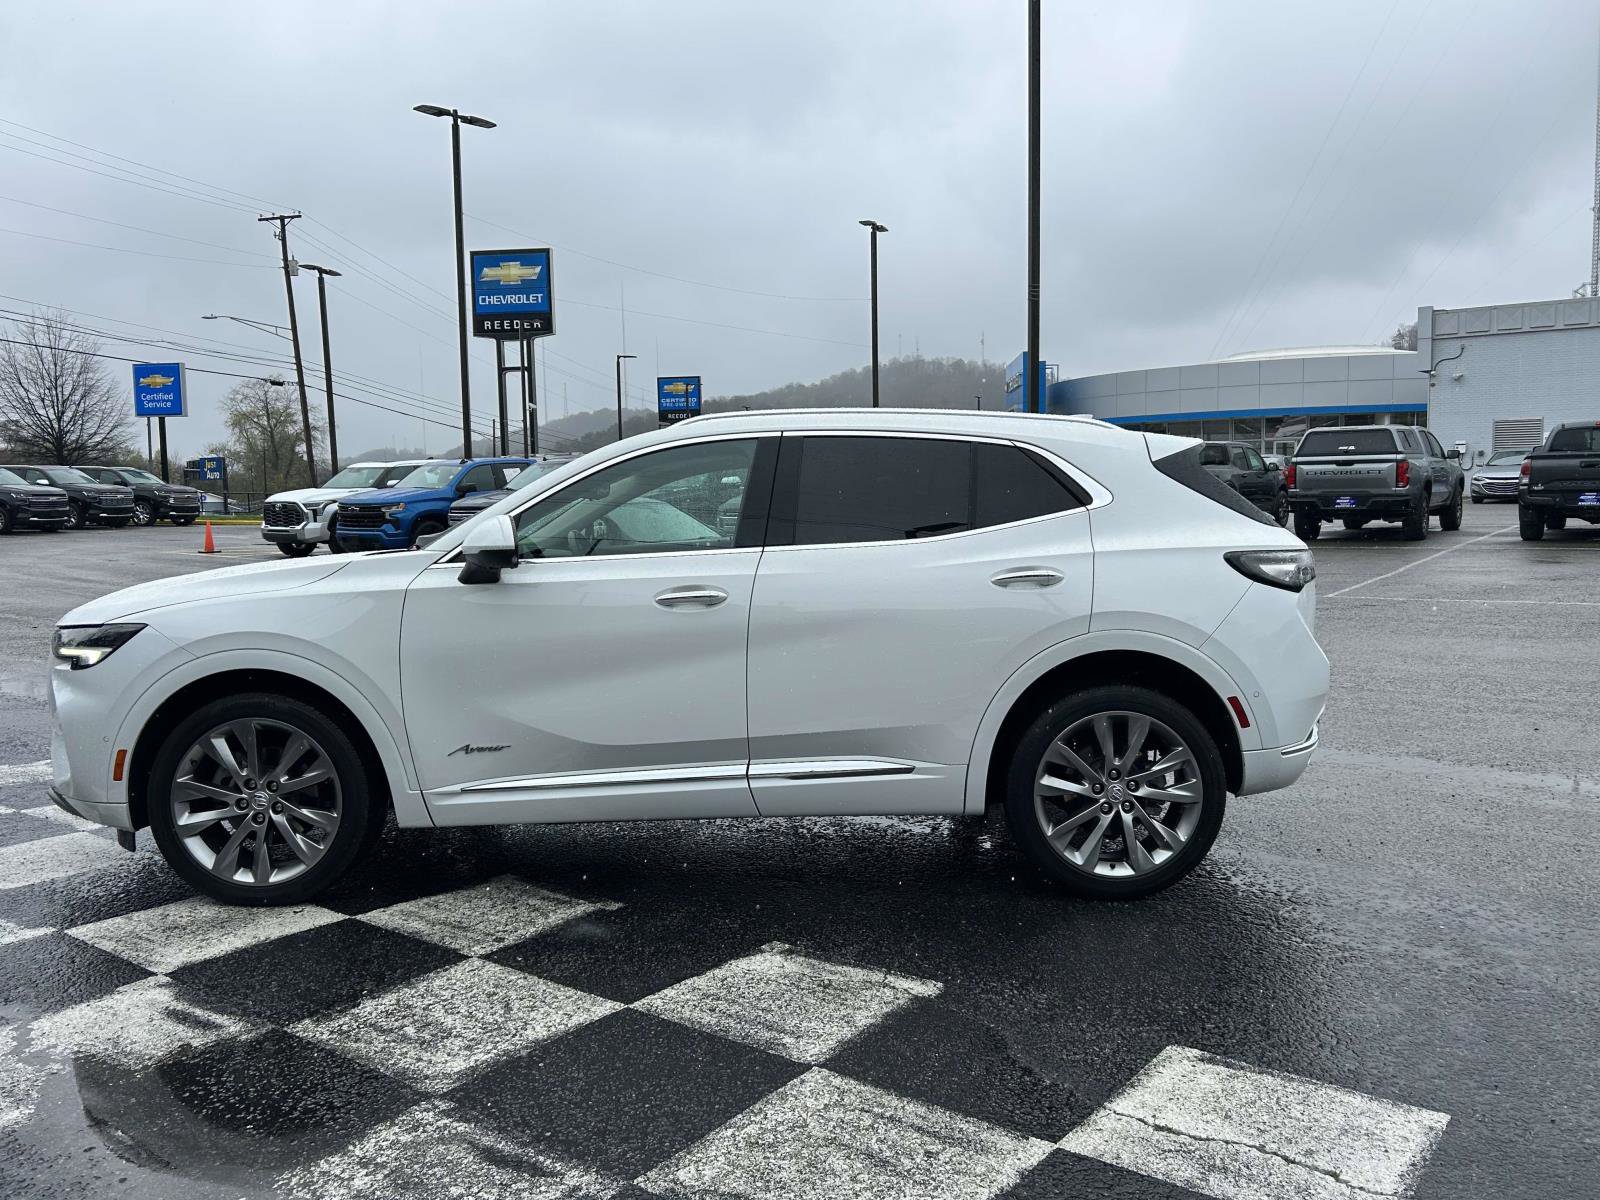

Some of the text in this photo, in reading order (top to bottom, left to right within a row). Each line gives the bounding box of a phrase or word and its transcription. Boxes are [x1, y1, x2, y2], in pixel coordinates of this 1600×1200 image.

[478, 293, 543, 305] CHEVROLET
[484, 320, 541, 330] REEDER
[141, 392, 174, 401] Certified
[143, 400, 172, 408] Service
[1305, 469, 1385, 477] CHEVROLET
